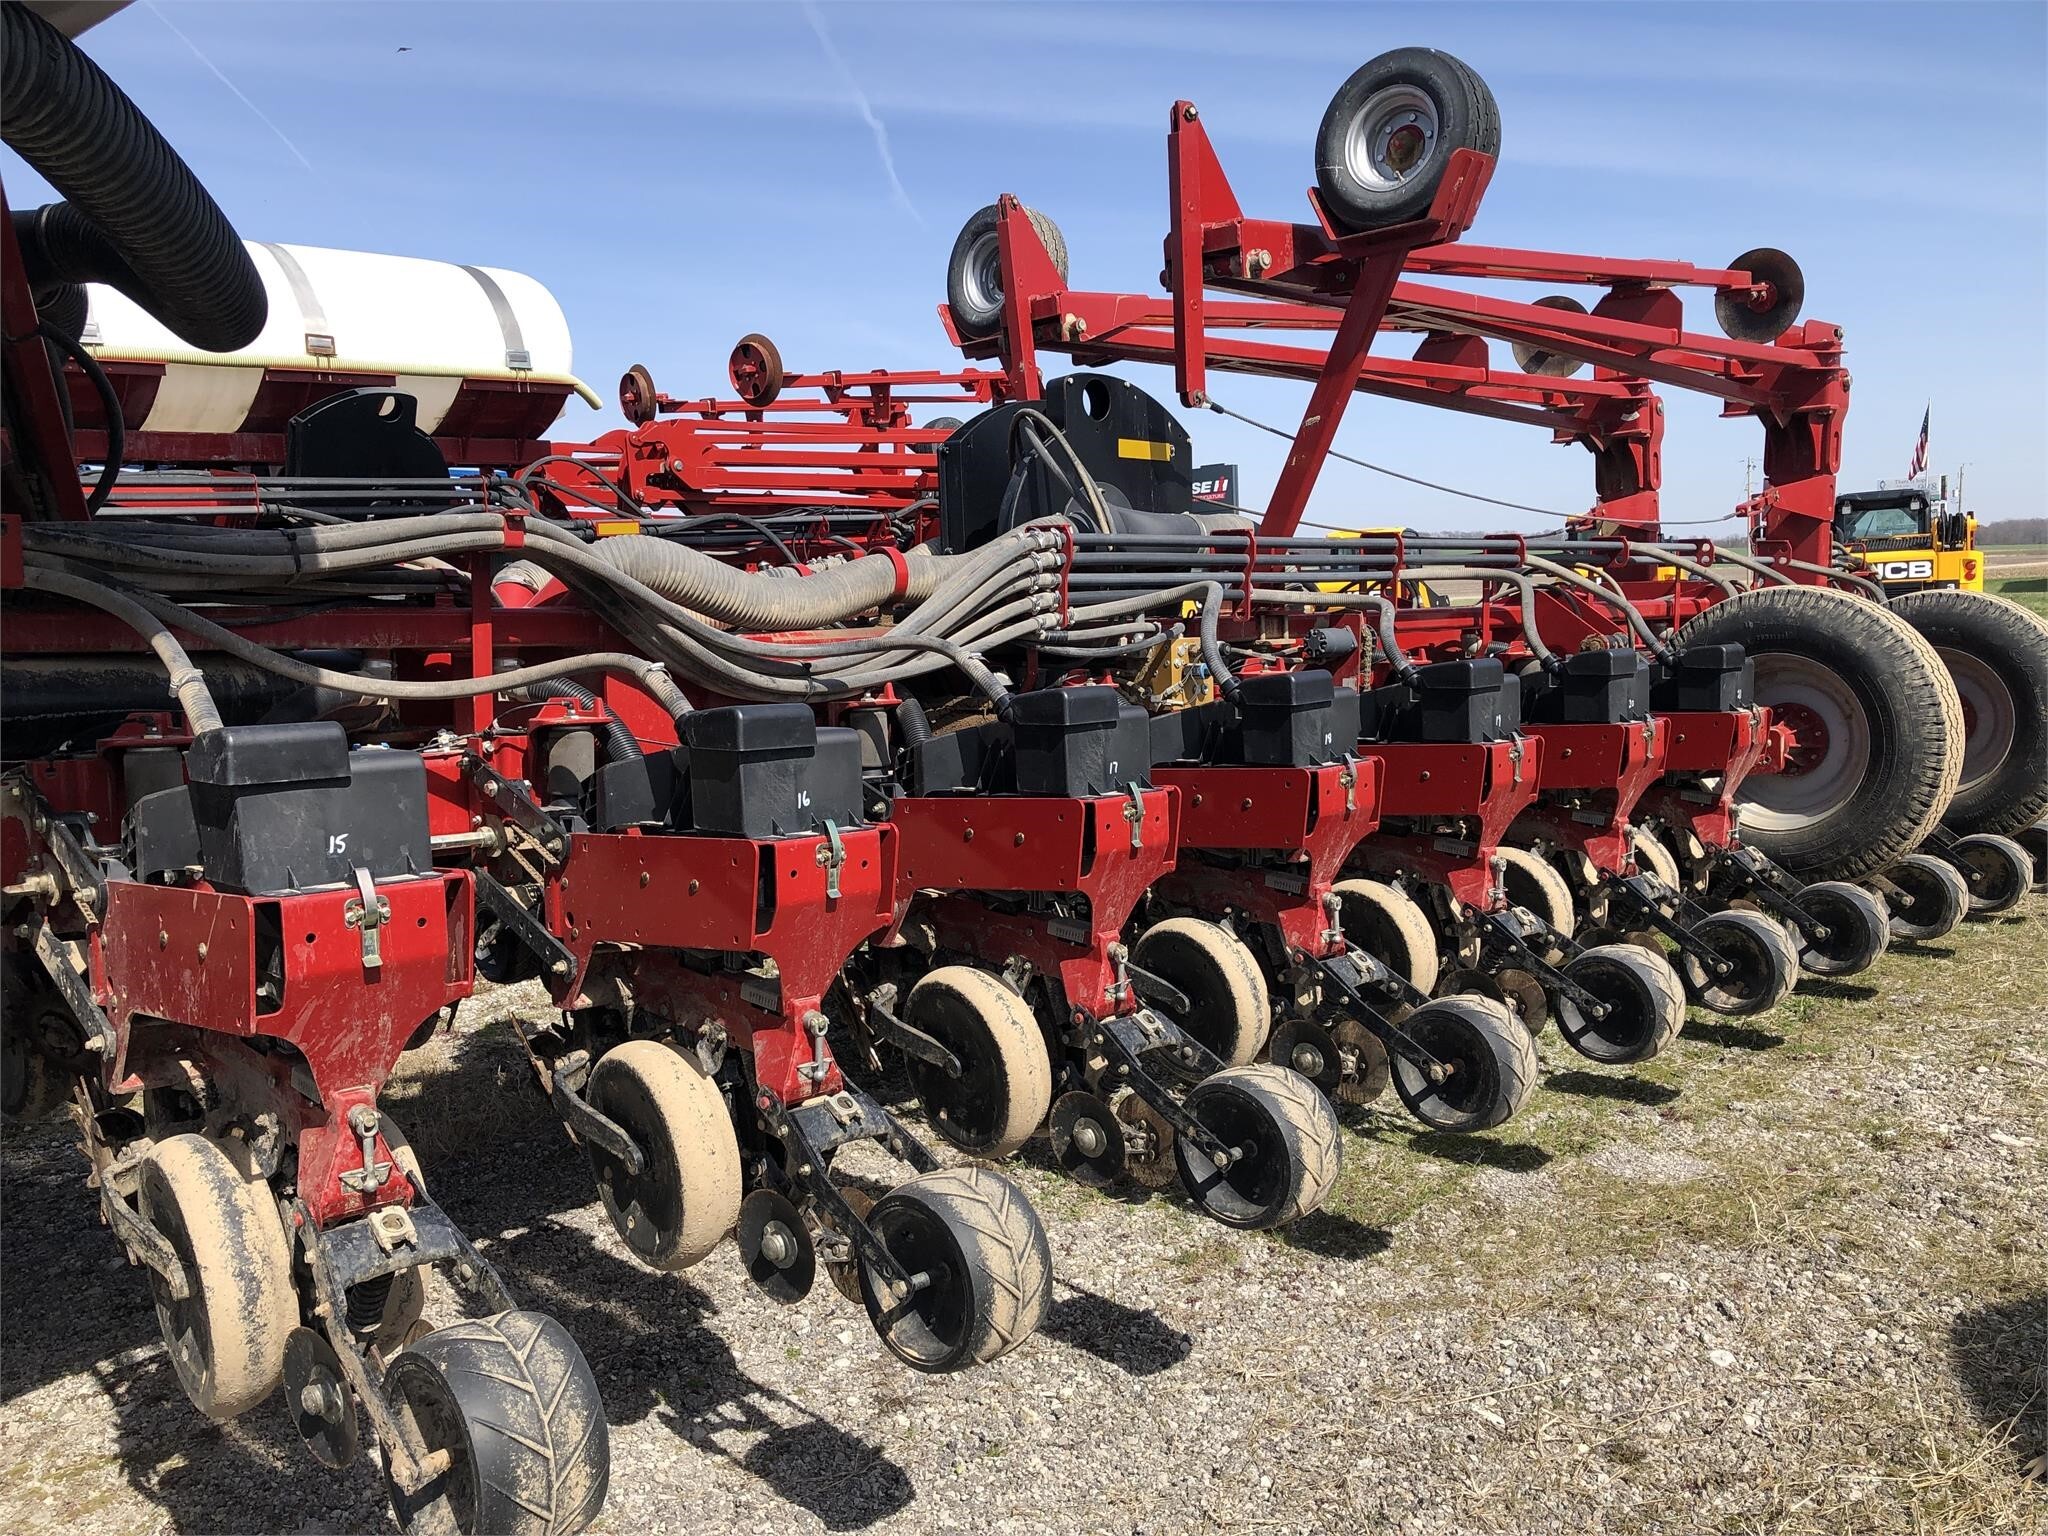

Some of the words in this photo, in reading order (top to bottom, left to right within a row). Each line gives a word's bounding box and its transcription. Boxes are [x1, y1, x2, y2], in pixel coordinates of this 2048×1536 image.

[1192, 481, 1212, 495] SE
[1109, 761, 1119, 775] 17
[797, 790, 811, 810] 16
[329, 833, 350, 854] 15
